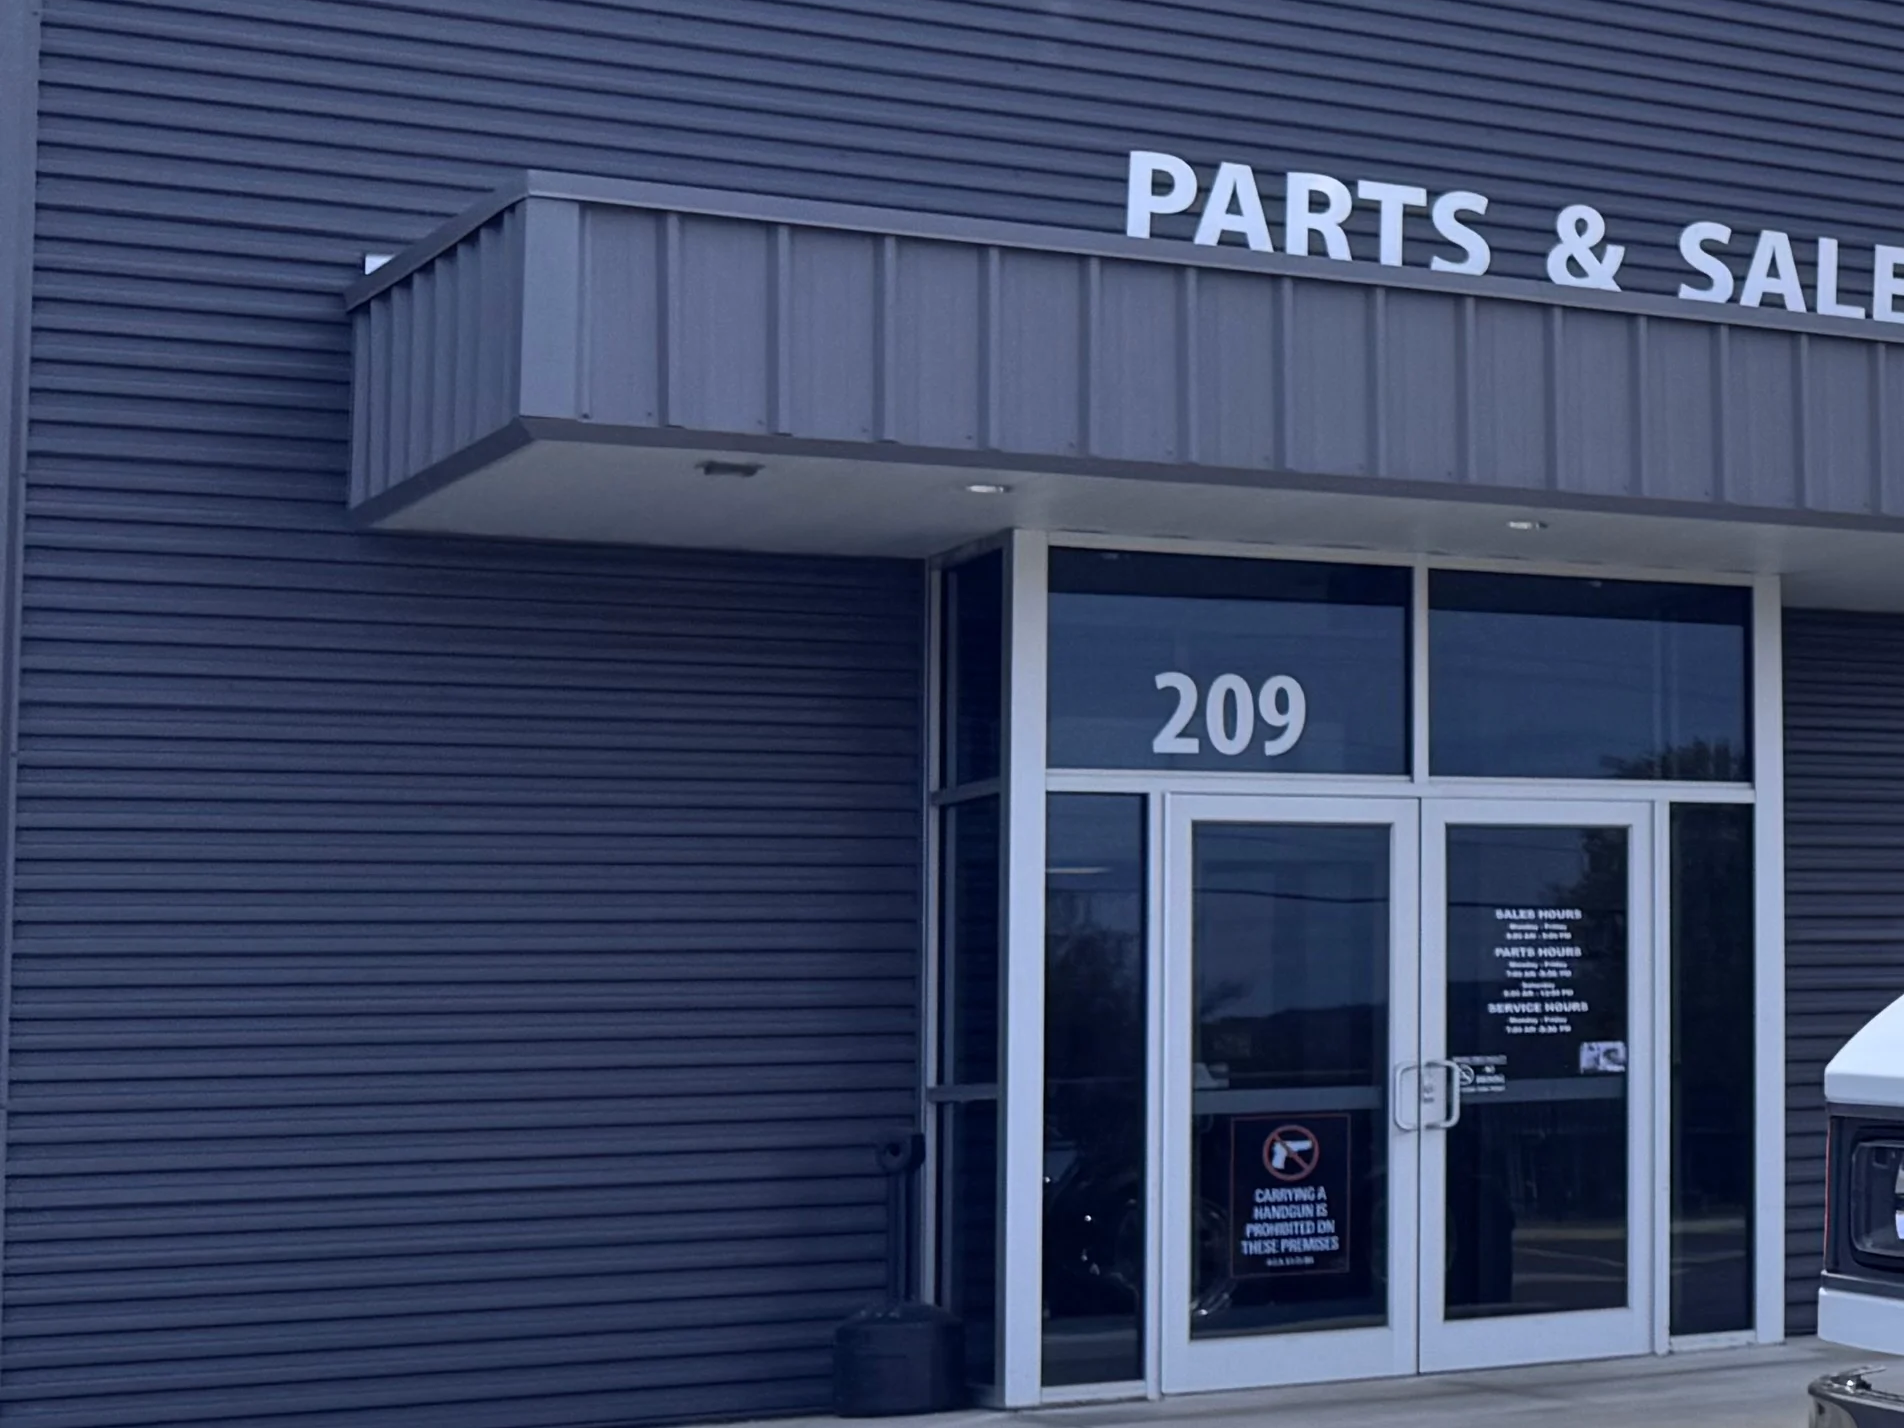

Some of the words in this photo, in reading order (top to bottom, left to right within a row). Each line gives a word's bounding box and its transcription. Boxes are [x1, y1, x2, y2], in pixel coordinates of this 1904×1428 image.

[1125, 149, 1492, 277] PARTS
[1546, 203, 1626, 293] &
[1152, 671, 1307, 757] 209
[1252, 1203, 1314, 1220] HANDGUN
[1254, 1186, 1316, 1203] CARRYING
[1317, 1185, 1327, 1201] A
